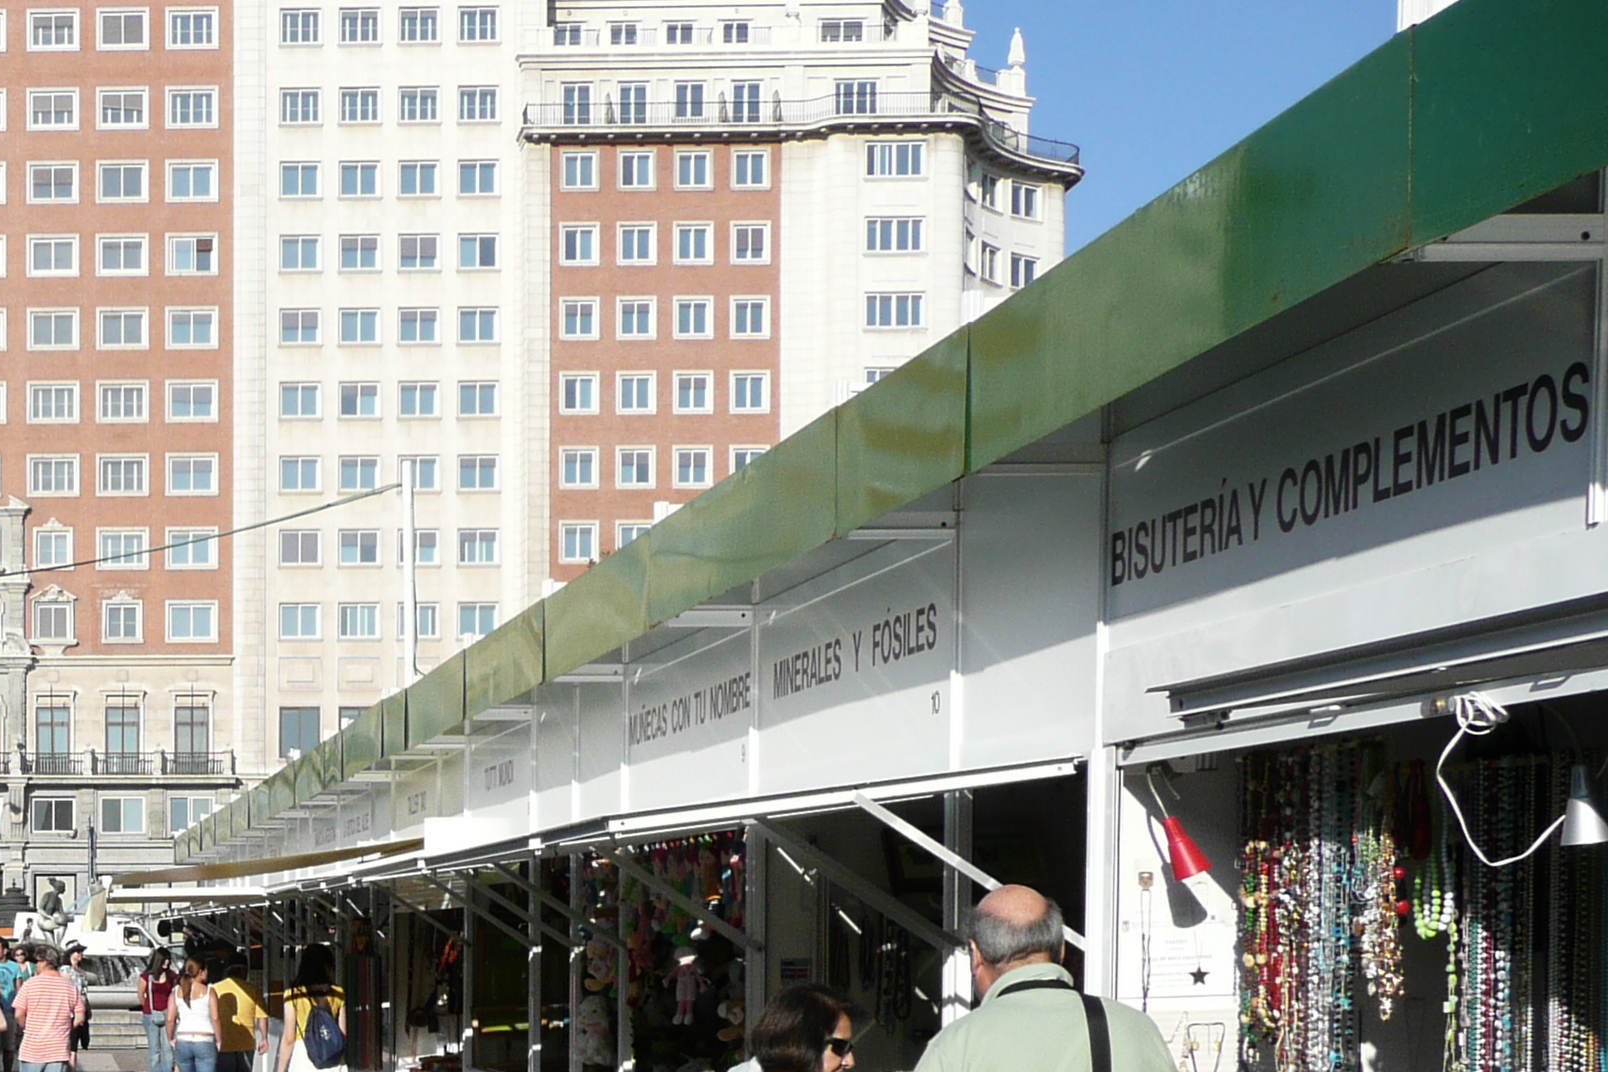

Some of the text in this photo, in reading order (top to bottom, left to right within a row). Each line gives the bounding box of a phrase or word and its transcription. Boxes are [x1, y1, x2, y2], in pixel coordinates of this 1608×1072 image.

[1110, 361, 1590, 586] BISUTERÍA Y COMPLEMENTOS
[773, 604, 938, 699] MINERALES Y FÓSILES
[671, 696, 693, 734] CON
[693, 689, 708, 726] TU
[709, 671, 752, 722] NOMBRE
[930, 690, 941, 716] 10
